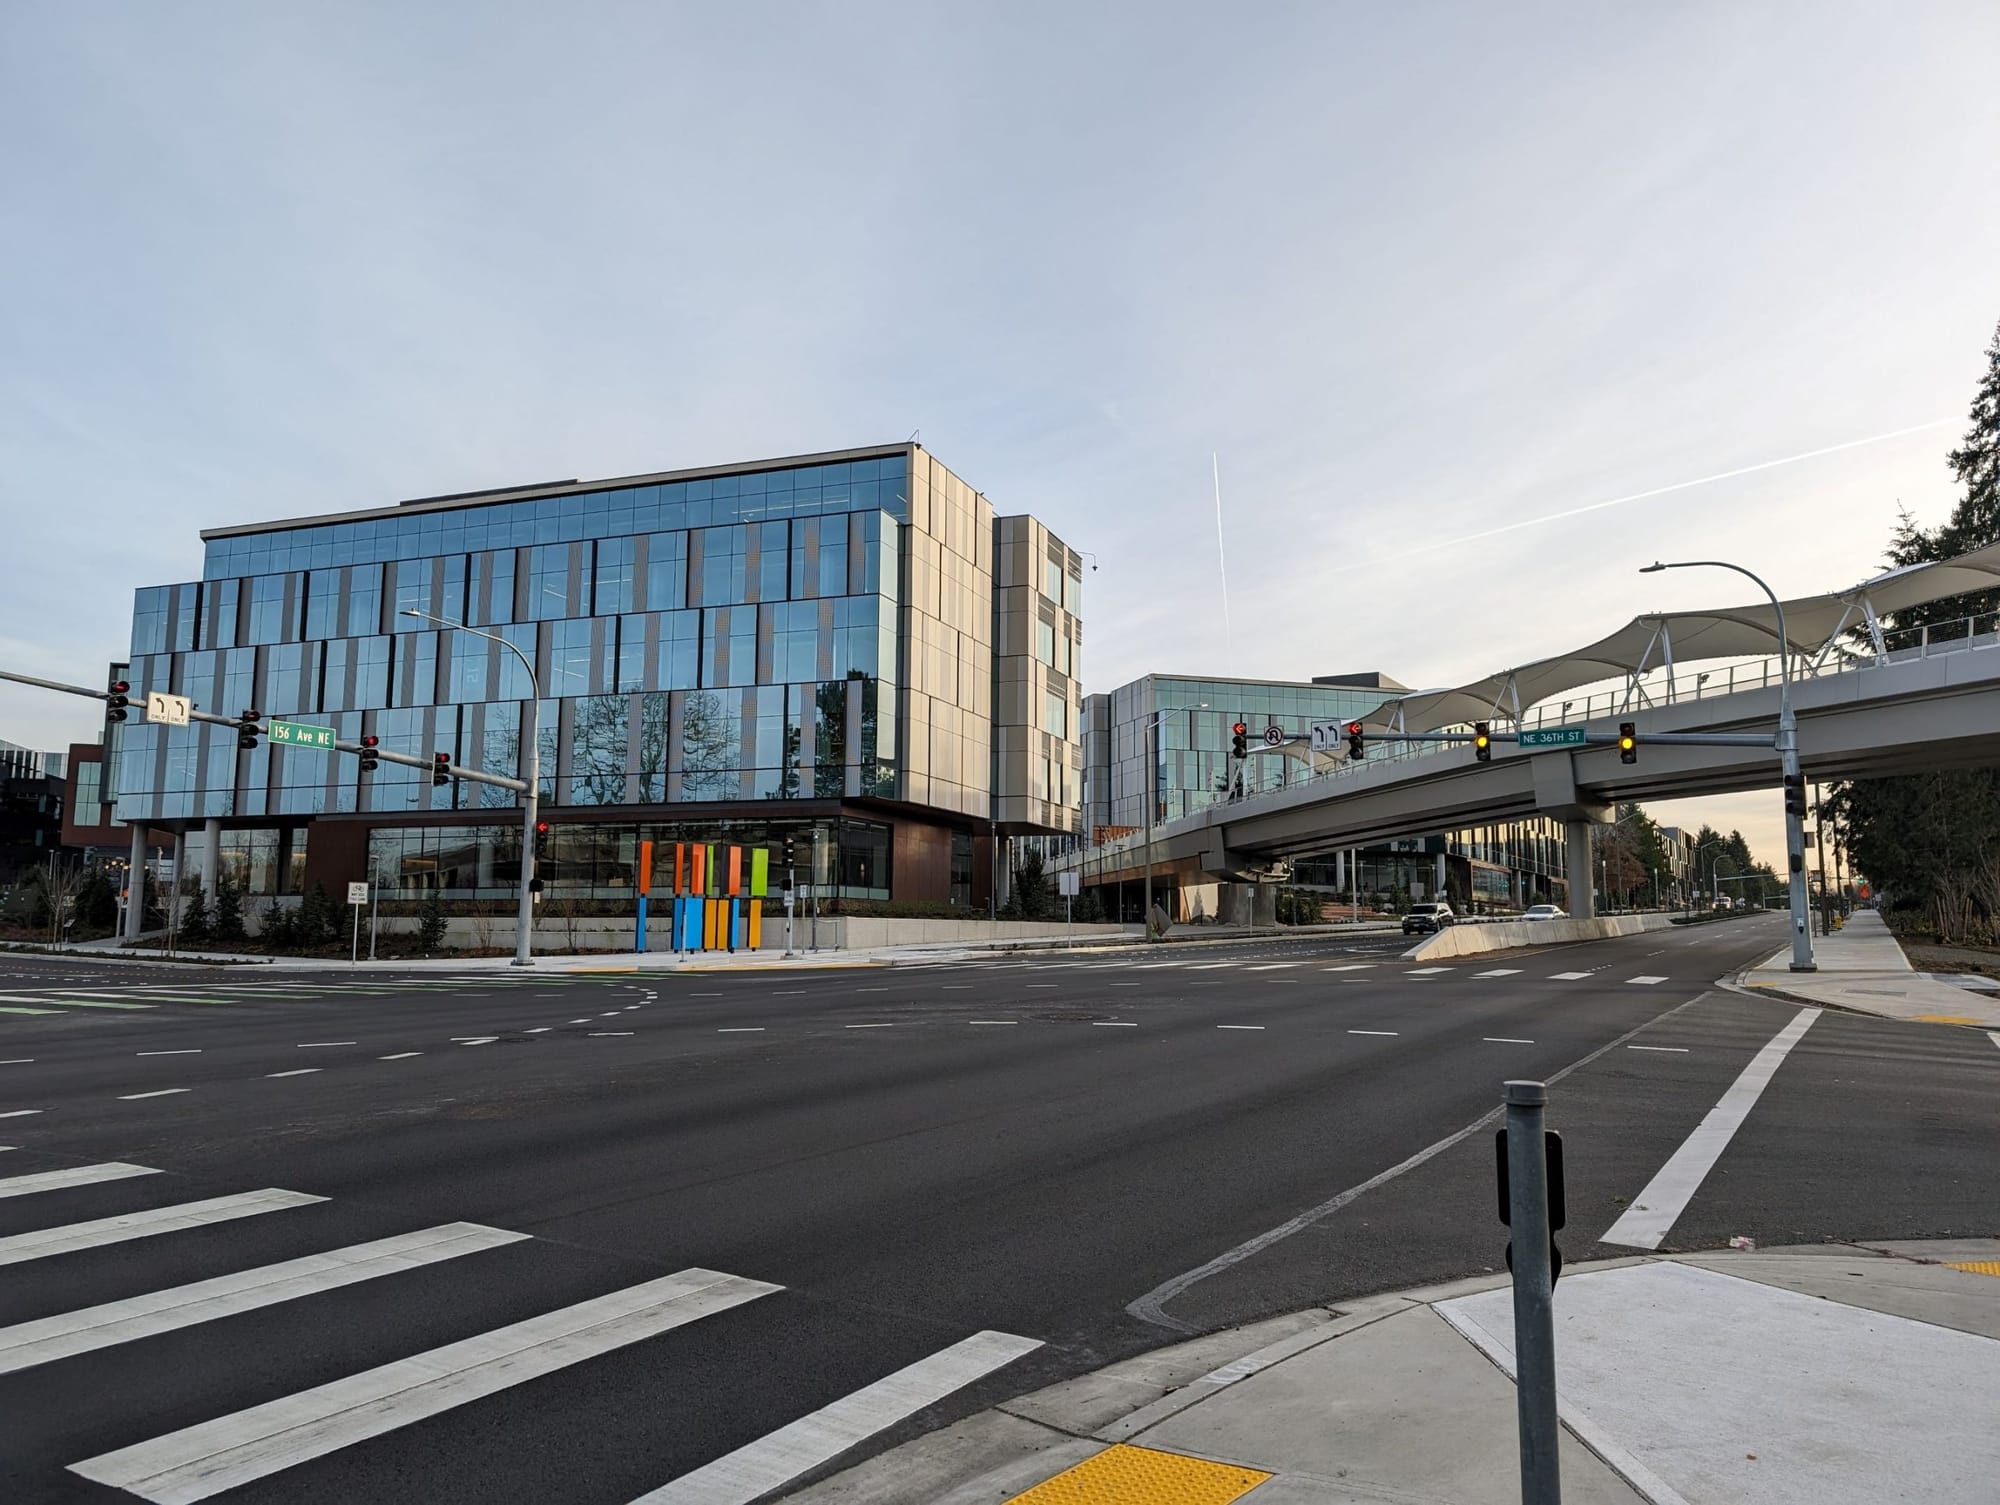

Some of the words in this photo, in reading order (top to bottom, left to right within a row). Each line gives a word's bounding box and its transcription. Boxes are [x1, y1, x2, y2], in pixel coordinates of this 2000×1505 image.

[274, 725, 290, 740] 156
[297, 729, 313, 742] Ave
[318, 732, 330, 745] NE
[1523, 734, 1536, 743] NE
[1540, 732, 1564, 743] 36TH
[1568, 731, 1580, 741] ST
